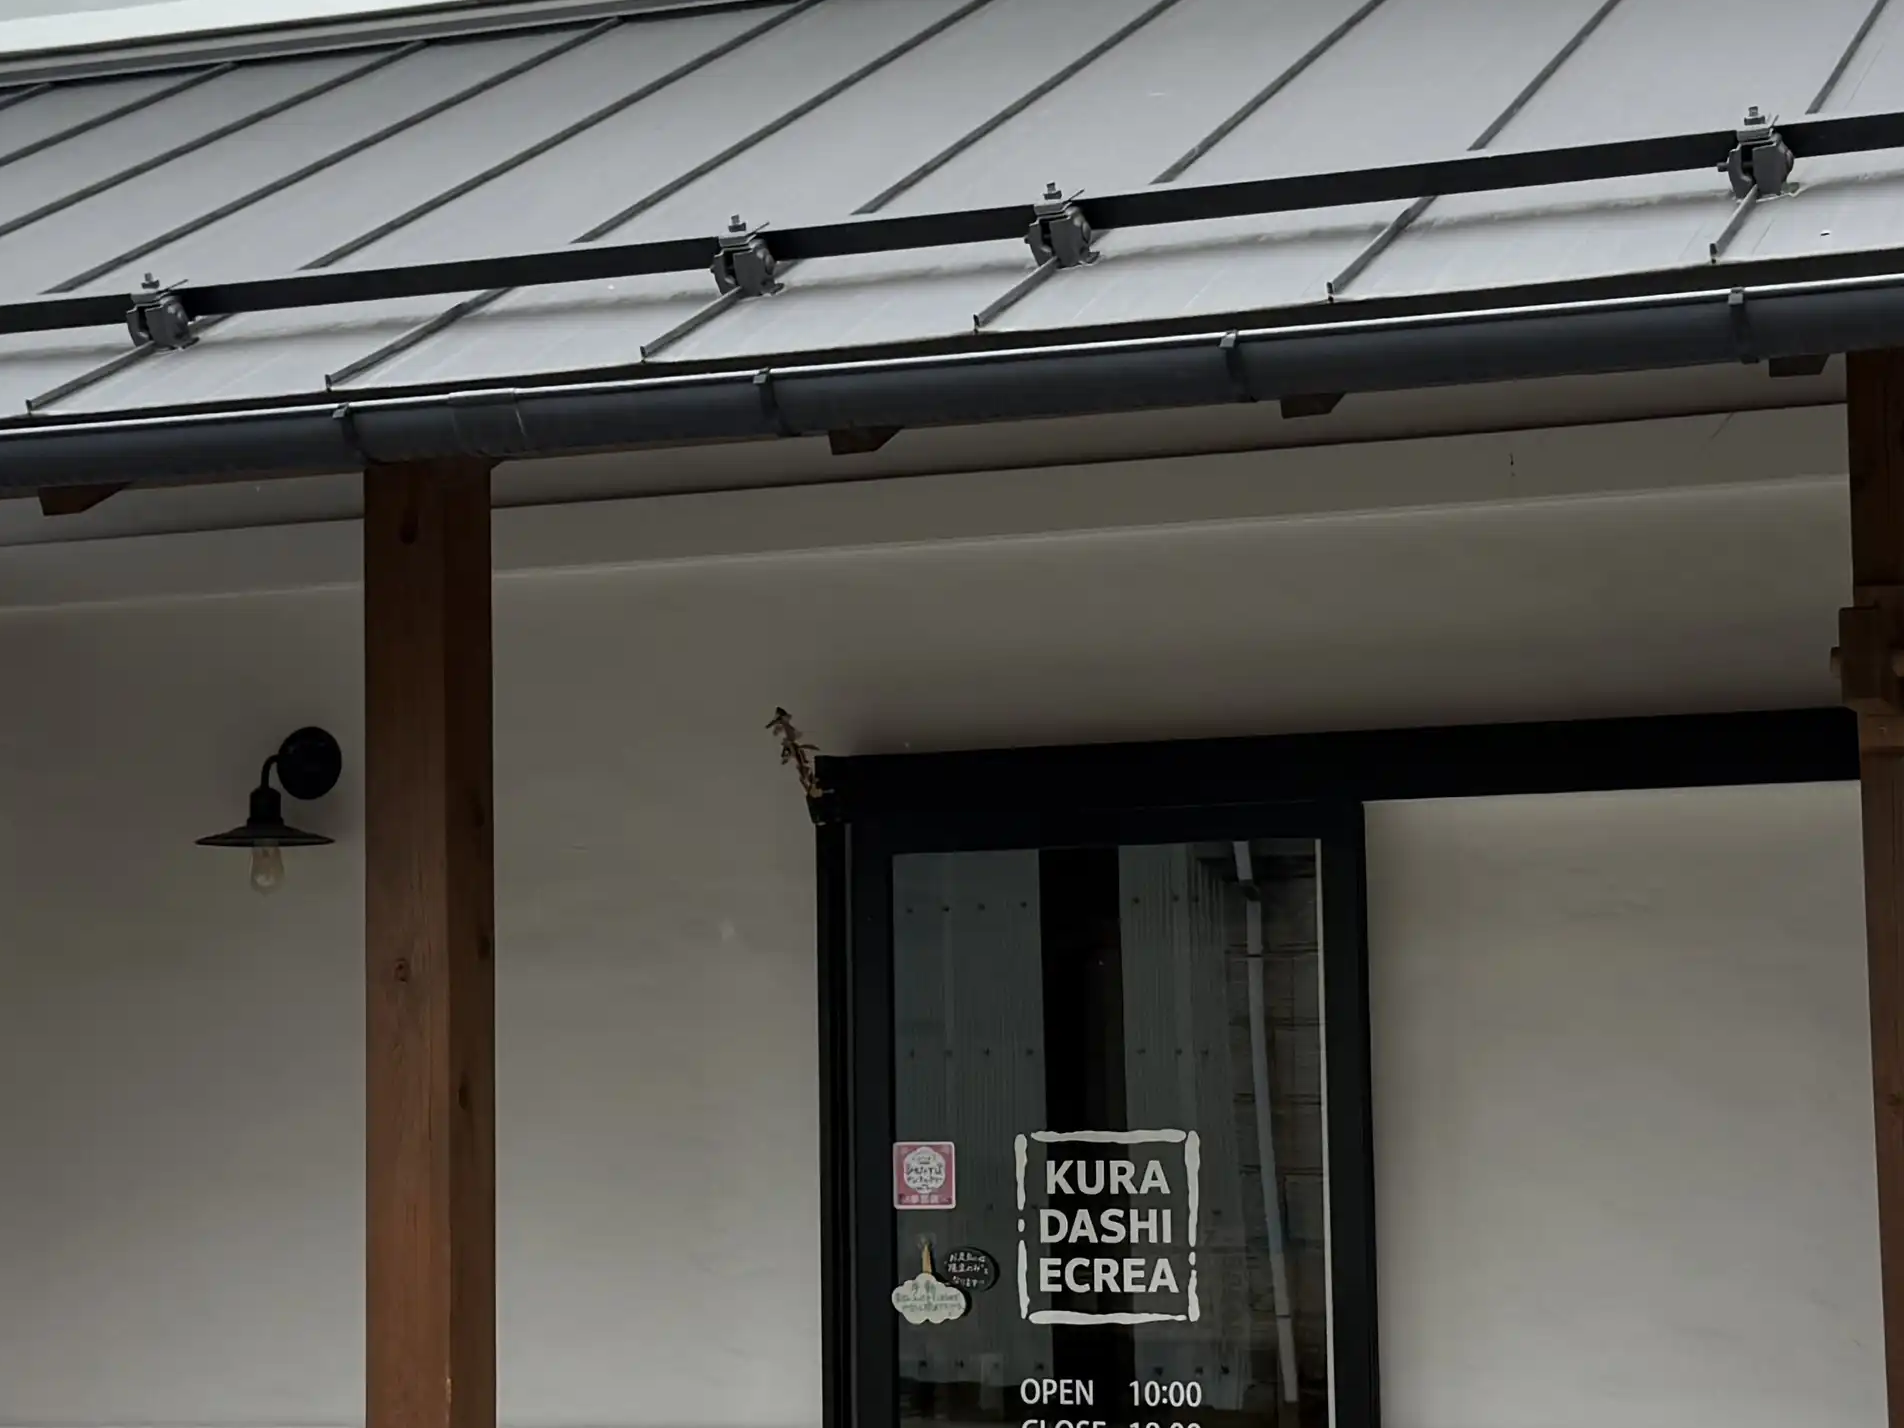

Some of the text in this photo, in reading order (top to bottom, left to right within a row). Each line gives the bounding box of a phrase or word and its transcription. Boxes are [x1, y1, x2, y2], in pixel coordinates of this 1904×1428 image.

[1046, 1160, 1171, 1195] KURA
[1039, 1208, 1172, 1244] DASHI
[1039, 1257, 1180, 1293] ECREA
[1020, 1378, 1202, 1408] OPEN 10:00
